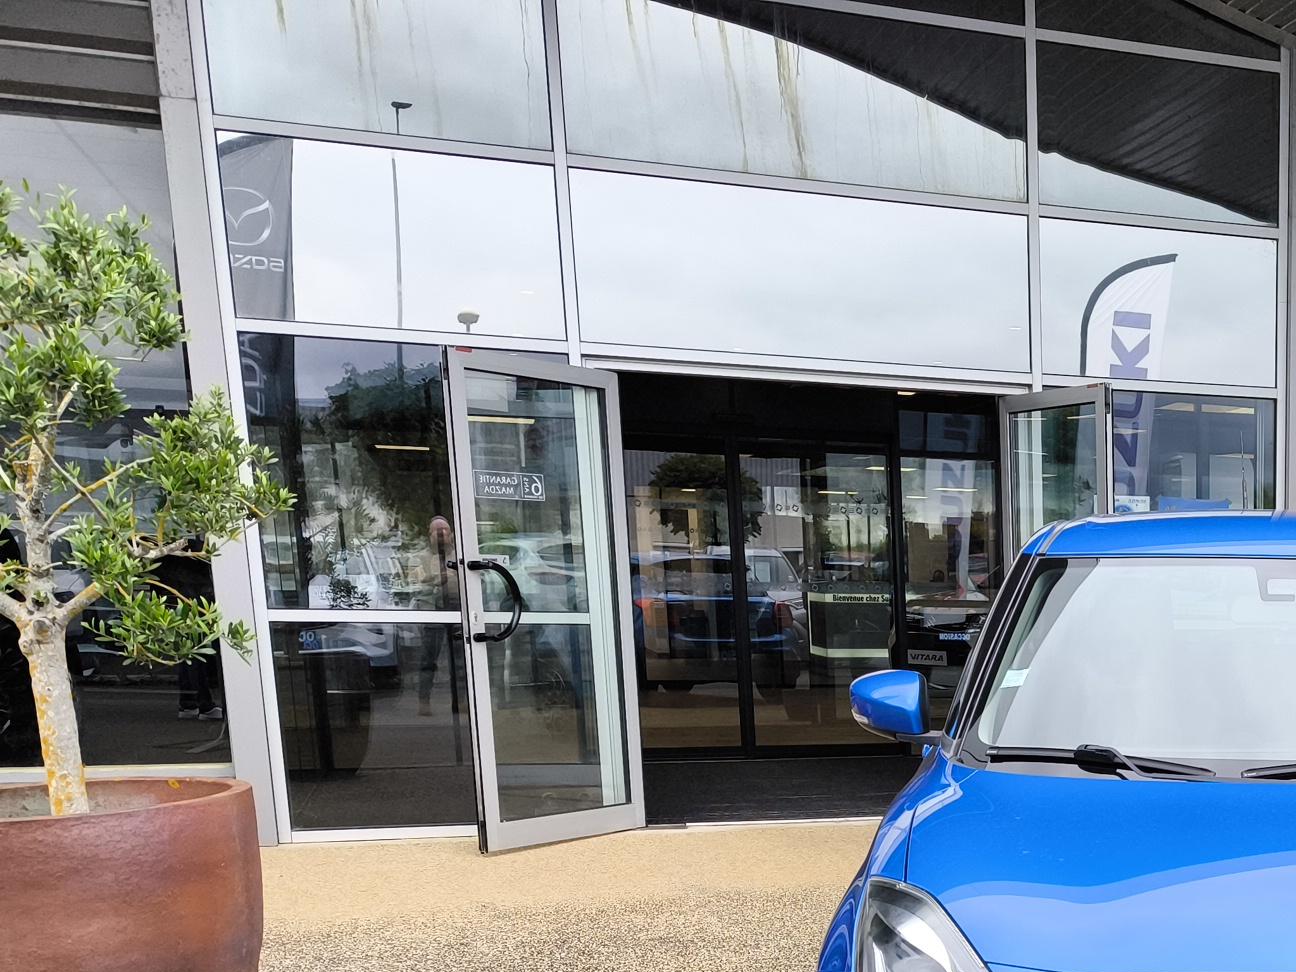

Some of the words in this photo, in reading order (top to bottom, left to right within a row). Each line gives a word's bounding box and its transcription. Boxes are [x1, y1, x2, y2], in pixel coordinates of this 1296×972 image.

[832, 594, 864, 602] Bienvenue
[865, 594, 880, 602] chez
[910, 653, 944, 663] VITARA
